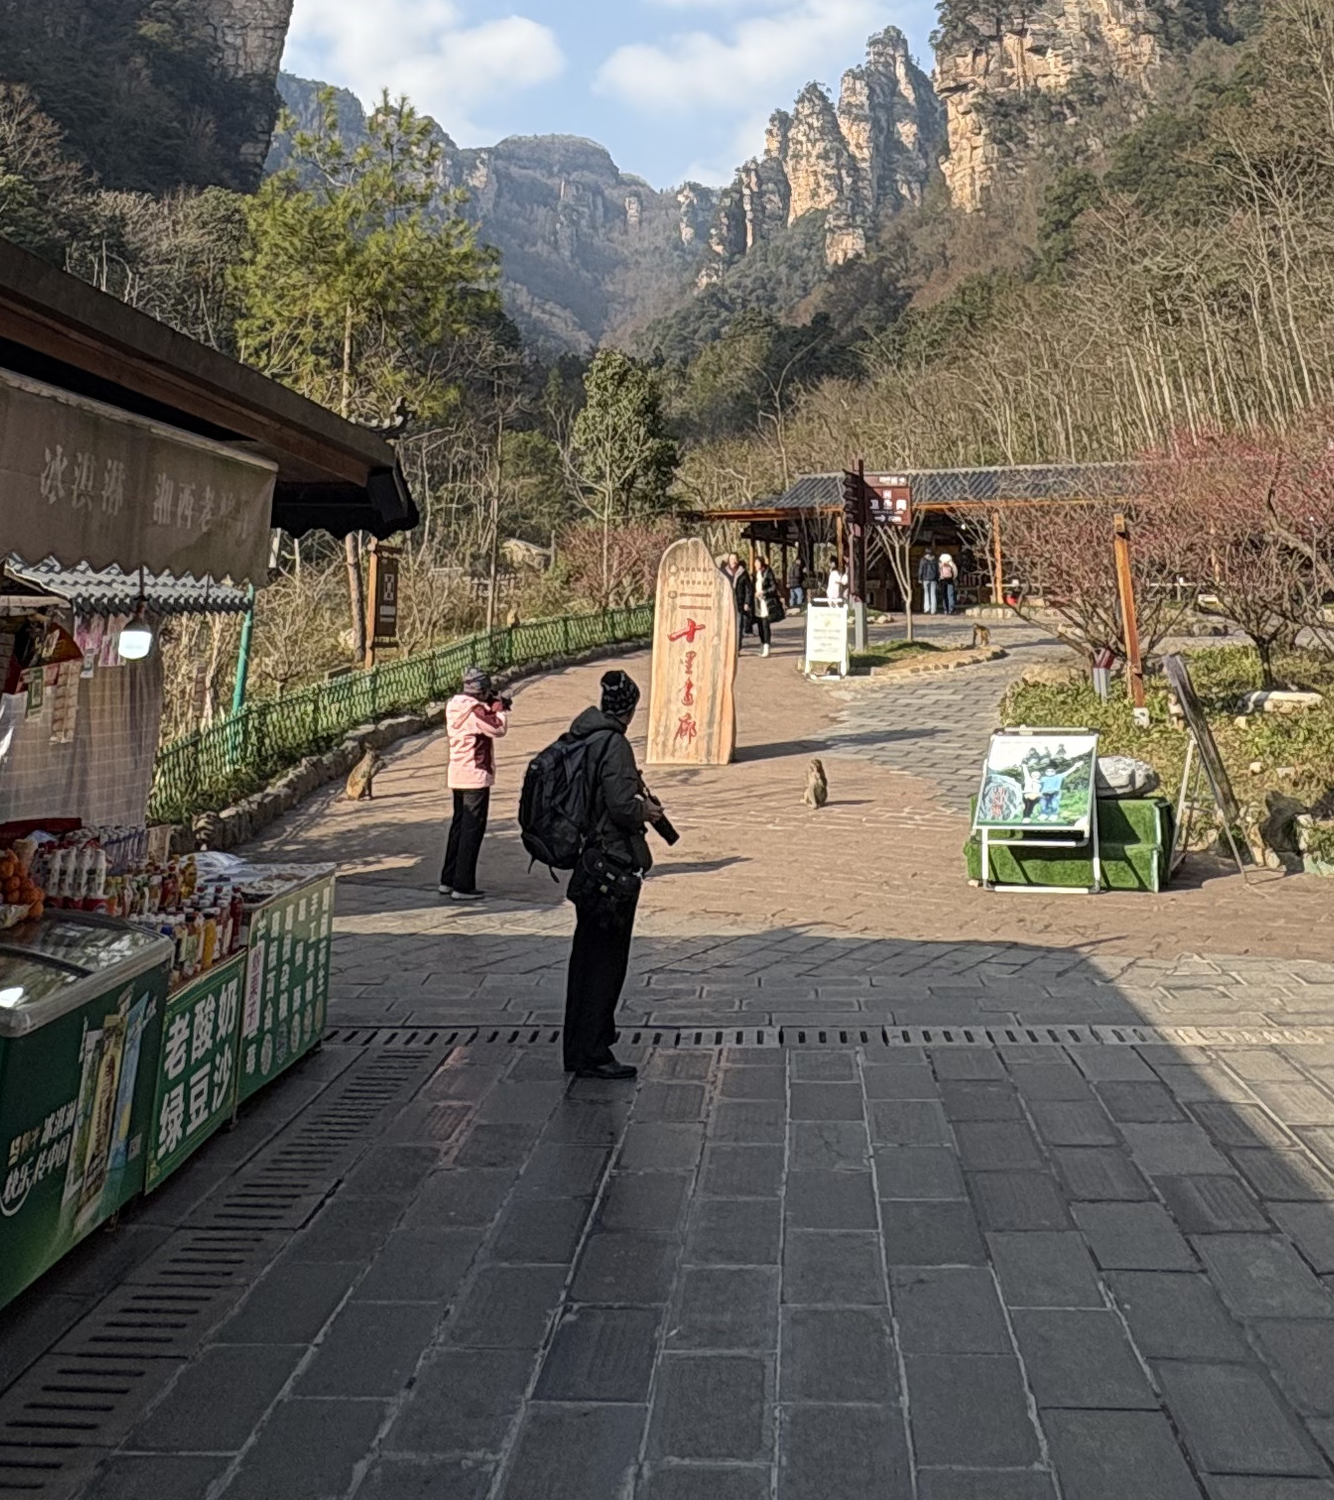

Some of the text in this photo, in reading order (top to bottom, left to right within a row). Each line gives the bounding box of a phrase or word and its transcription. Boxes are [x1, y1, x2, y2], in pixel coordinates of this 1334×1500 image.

[40, 443, 125, 517] 冰淇淋
[164, 977, 239, 1080] 老酸奶
[157, 1042, 233, 1161] 绿豆沙
